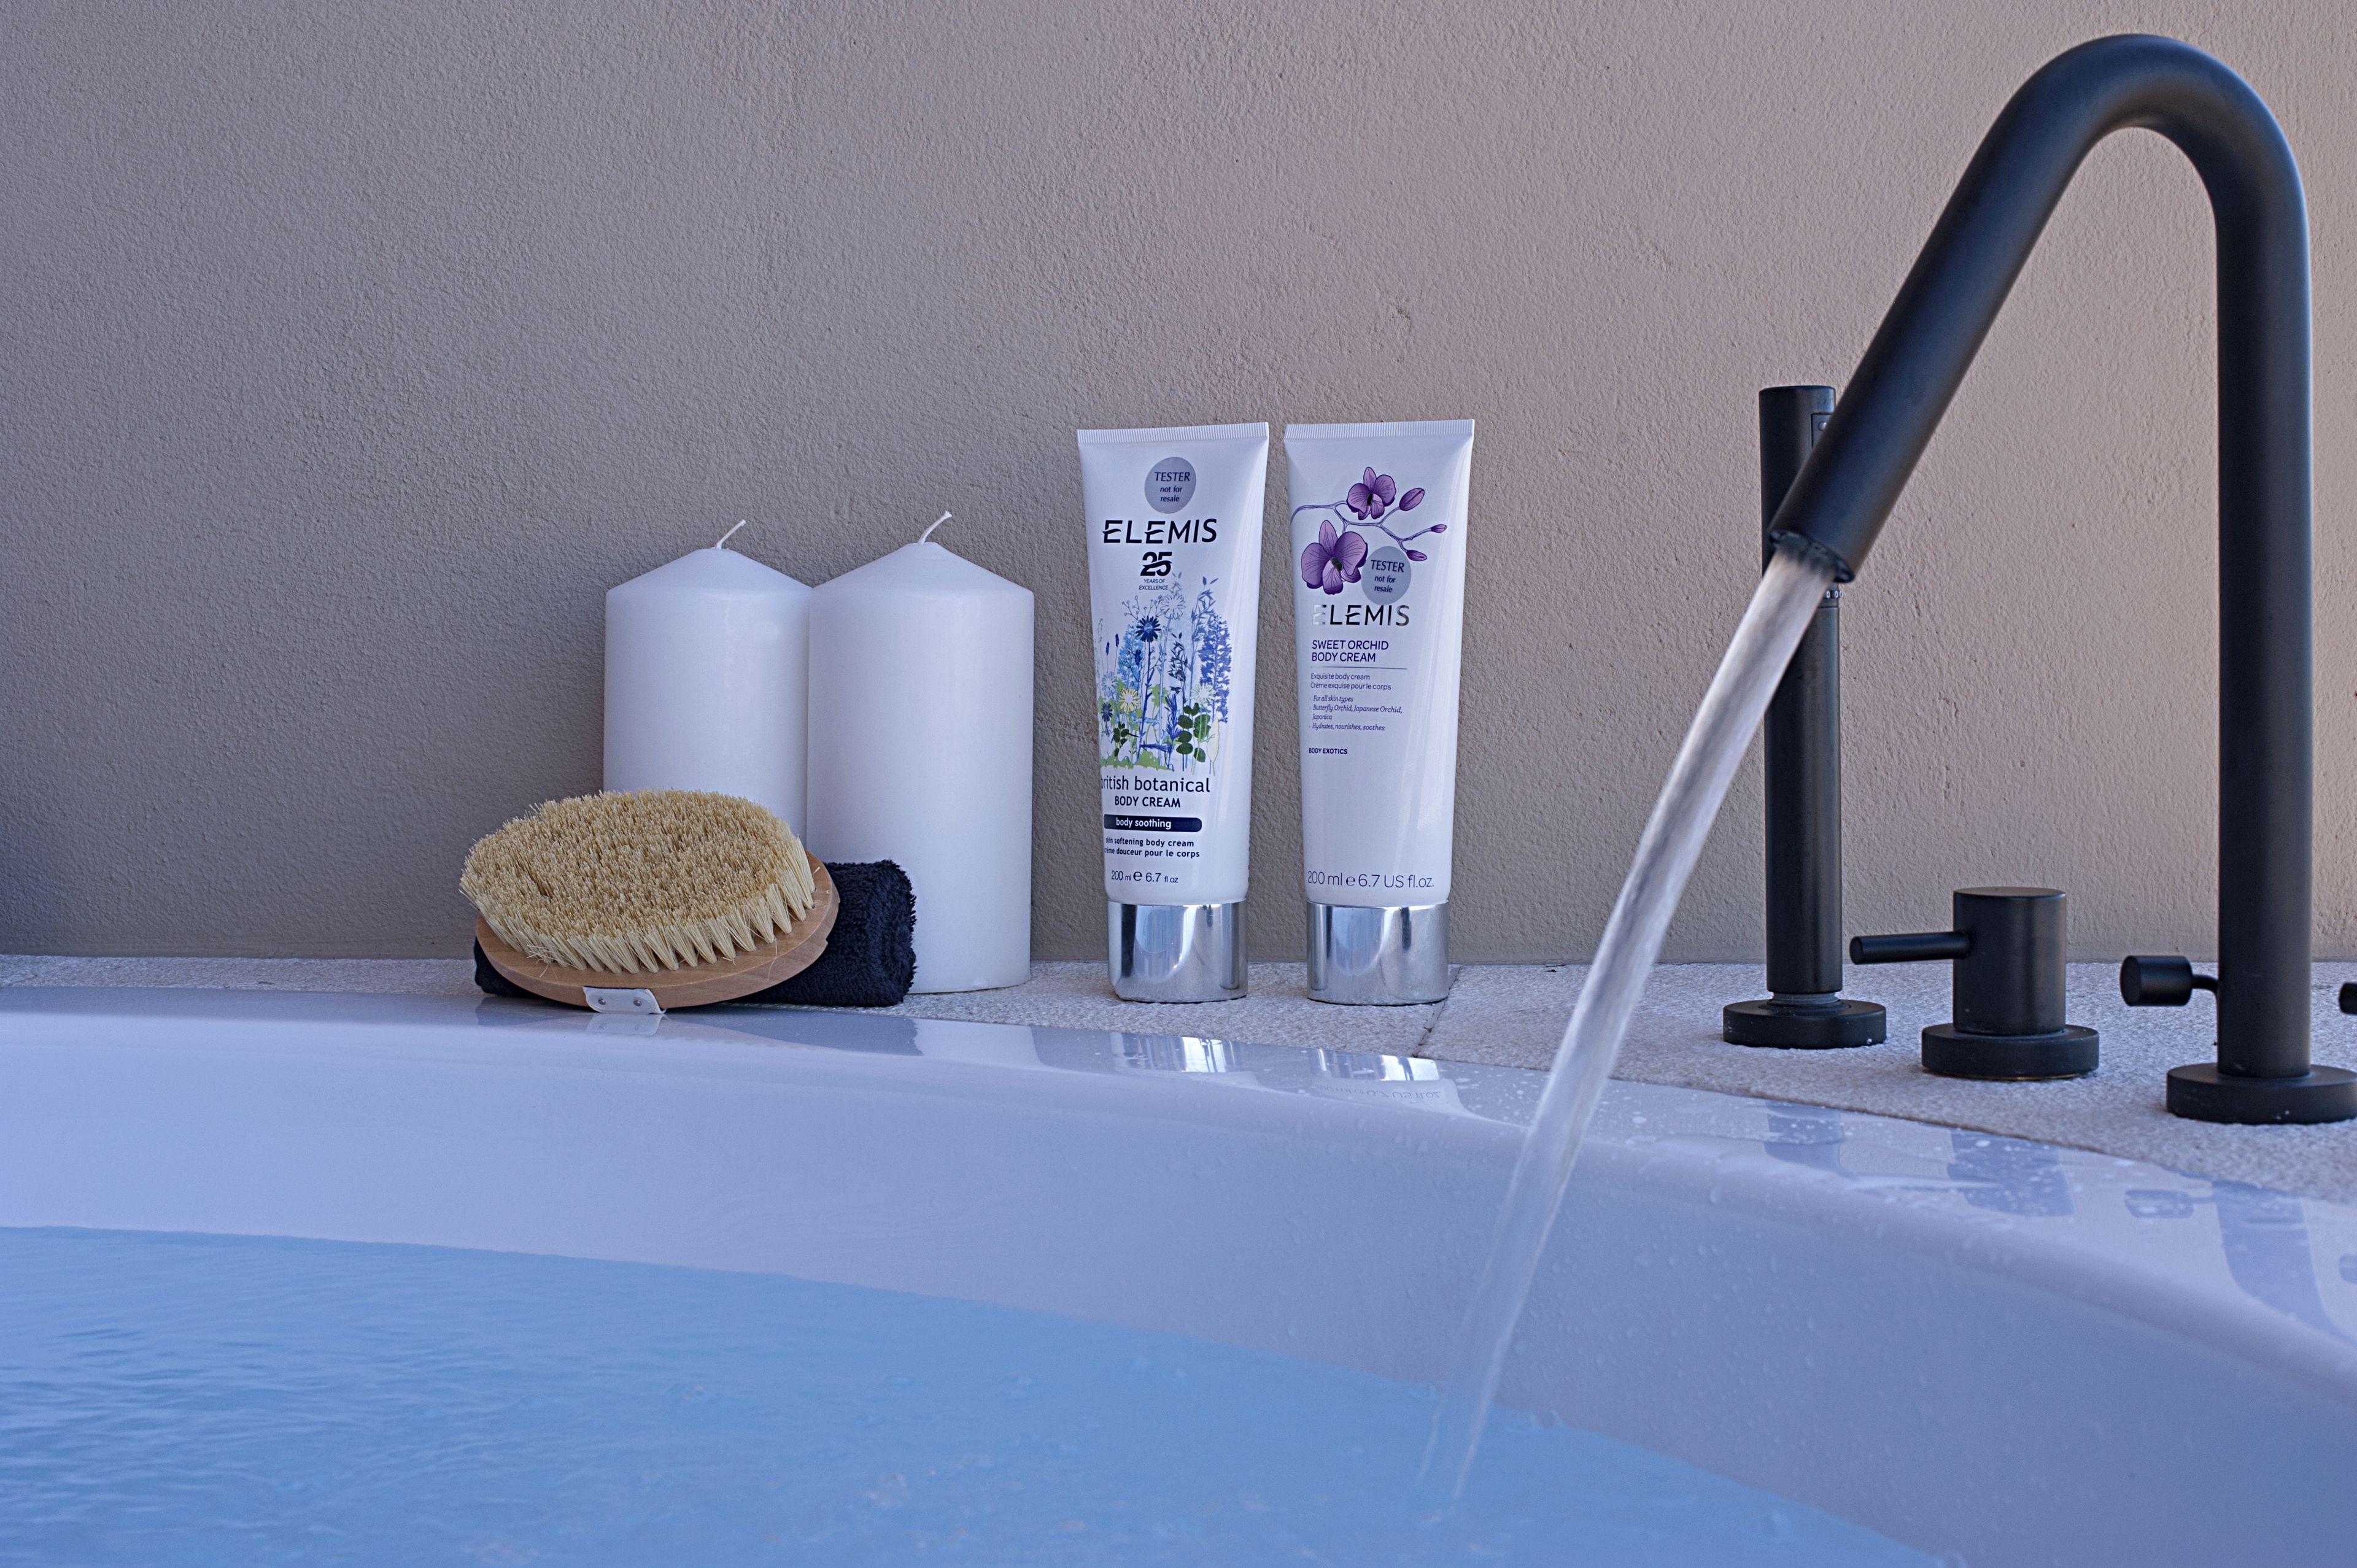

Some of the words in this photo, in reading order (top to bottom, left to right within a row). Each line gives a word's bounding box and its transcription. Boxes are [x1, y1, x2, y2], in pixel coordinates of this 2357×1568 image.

[1155, 472, 1190, 482] TESTER
[1102, 519, 1217, 544] ELEMIS
[1140, 551, 1172, 576] 25
[1371, 559, 1404, 573] TESTER
[1374, 584, 1393, 593] resale
[1312, 604, 1409, 626] ELEMIS
[1312, 640, 1345, 650] SWEET
[1348, 640, 1389, 651] ORCHID
[1312, 652, 1338, 662] BODY
[1340, 652, 1376, 662] CREAM
[1313, 704, 1333, 713] Butterfly
[1134, 776, 1210, 792] botanical
[1115, 796, 1139, 806] BODY
[1142, 797, 1181, 808] CREAM
[1116, 817, 1133, 828] body
[1135, 819, 1172, 829] soothing
[1114, 837, 1144, 847] softening
[1146, 838, 1165, 848] body
[1116, 847, 1142, 855] douceur
[1112, 870, 1123, 881] 200
[1145, 873, 1161, 882] 6.7
[1307, 870, 1325, 884] 200
[1328, 872, 1342, 886] ml
[1358, 873, 1380, 887] 6.7
[1384, 875, 1404, 888] US
[1407, 875, 1434, 889] fl.oz.
